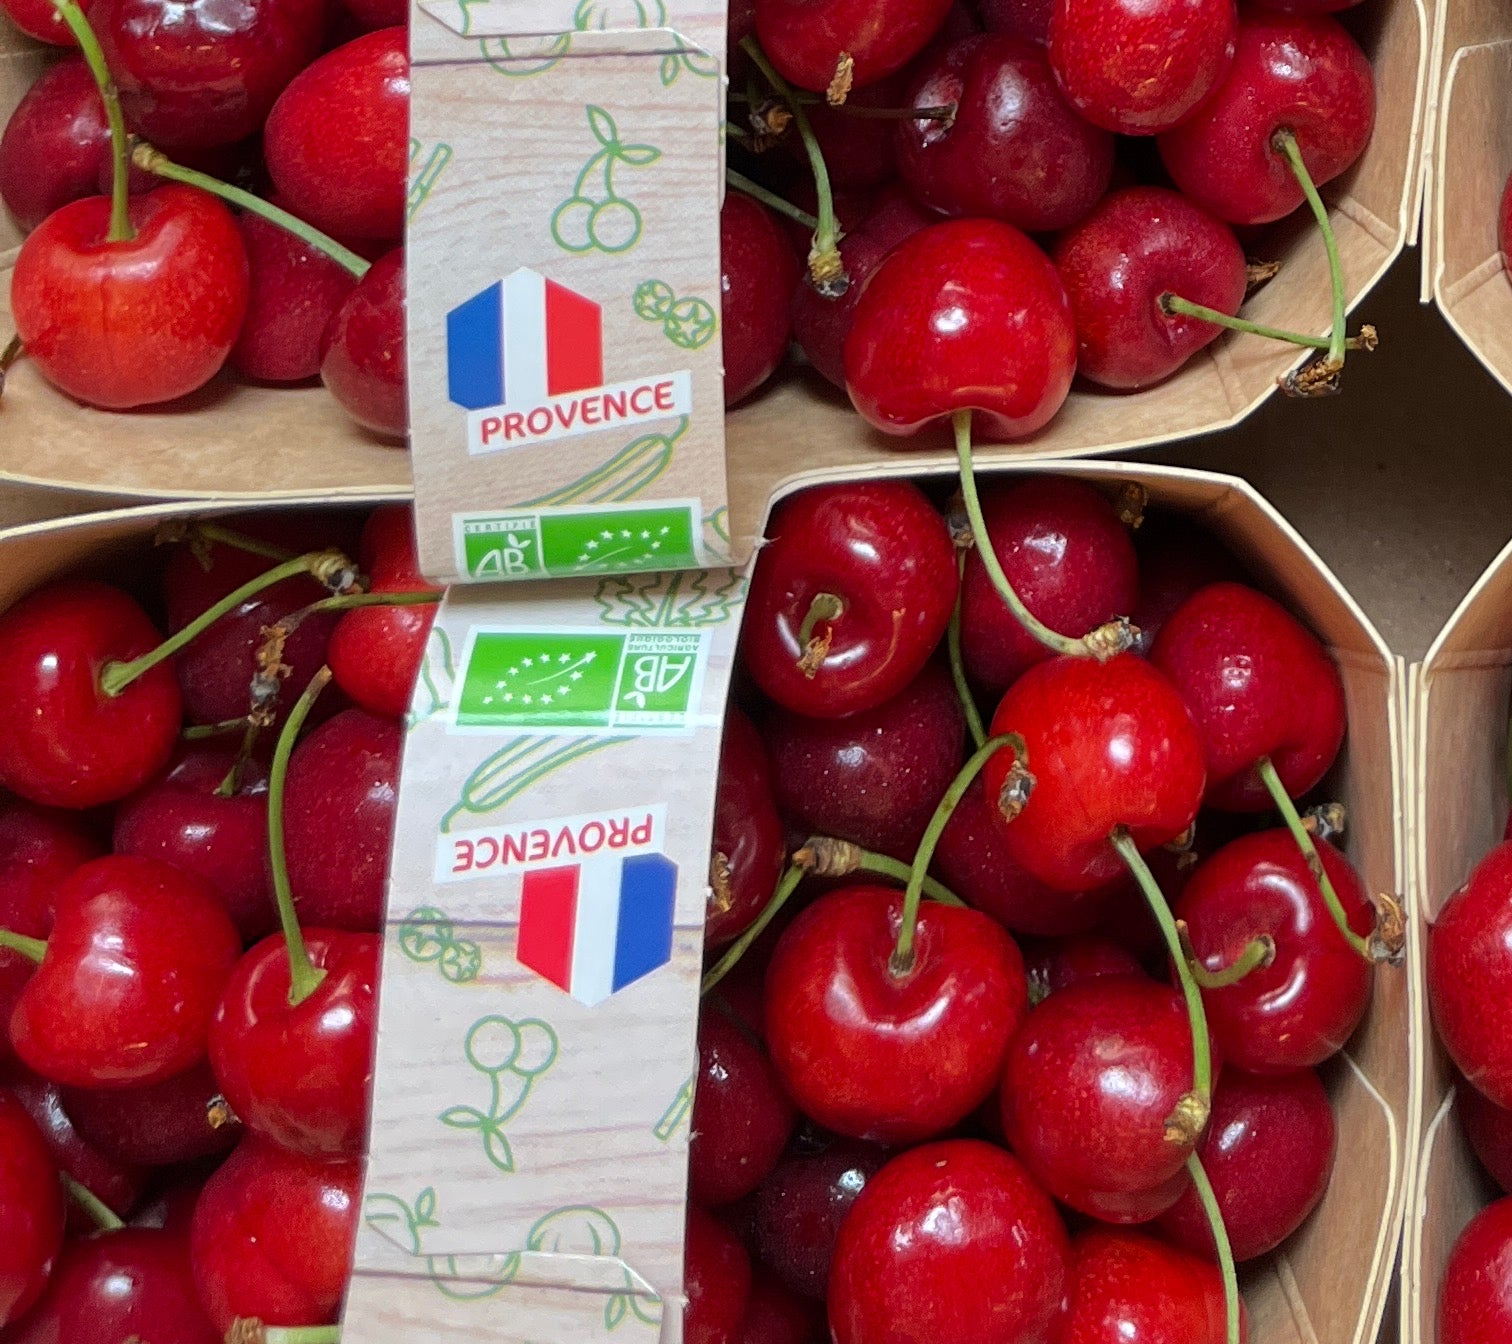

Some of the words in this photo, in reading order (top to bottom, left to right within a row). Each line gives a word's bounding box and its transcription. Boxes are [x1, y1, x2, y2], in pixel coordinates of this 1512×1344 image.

[481, 380, 675, 446] PROVENCE
[474, 548, 531, 578] AB
[626, 644, 700, 652] AGRICULTURE
[628, 635, 701, 644] BIOLOGIQUE
[633, 655, 692, 693] AB
[452, 813, 654, 873] PROVENCE
